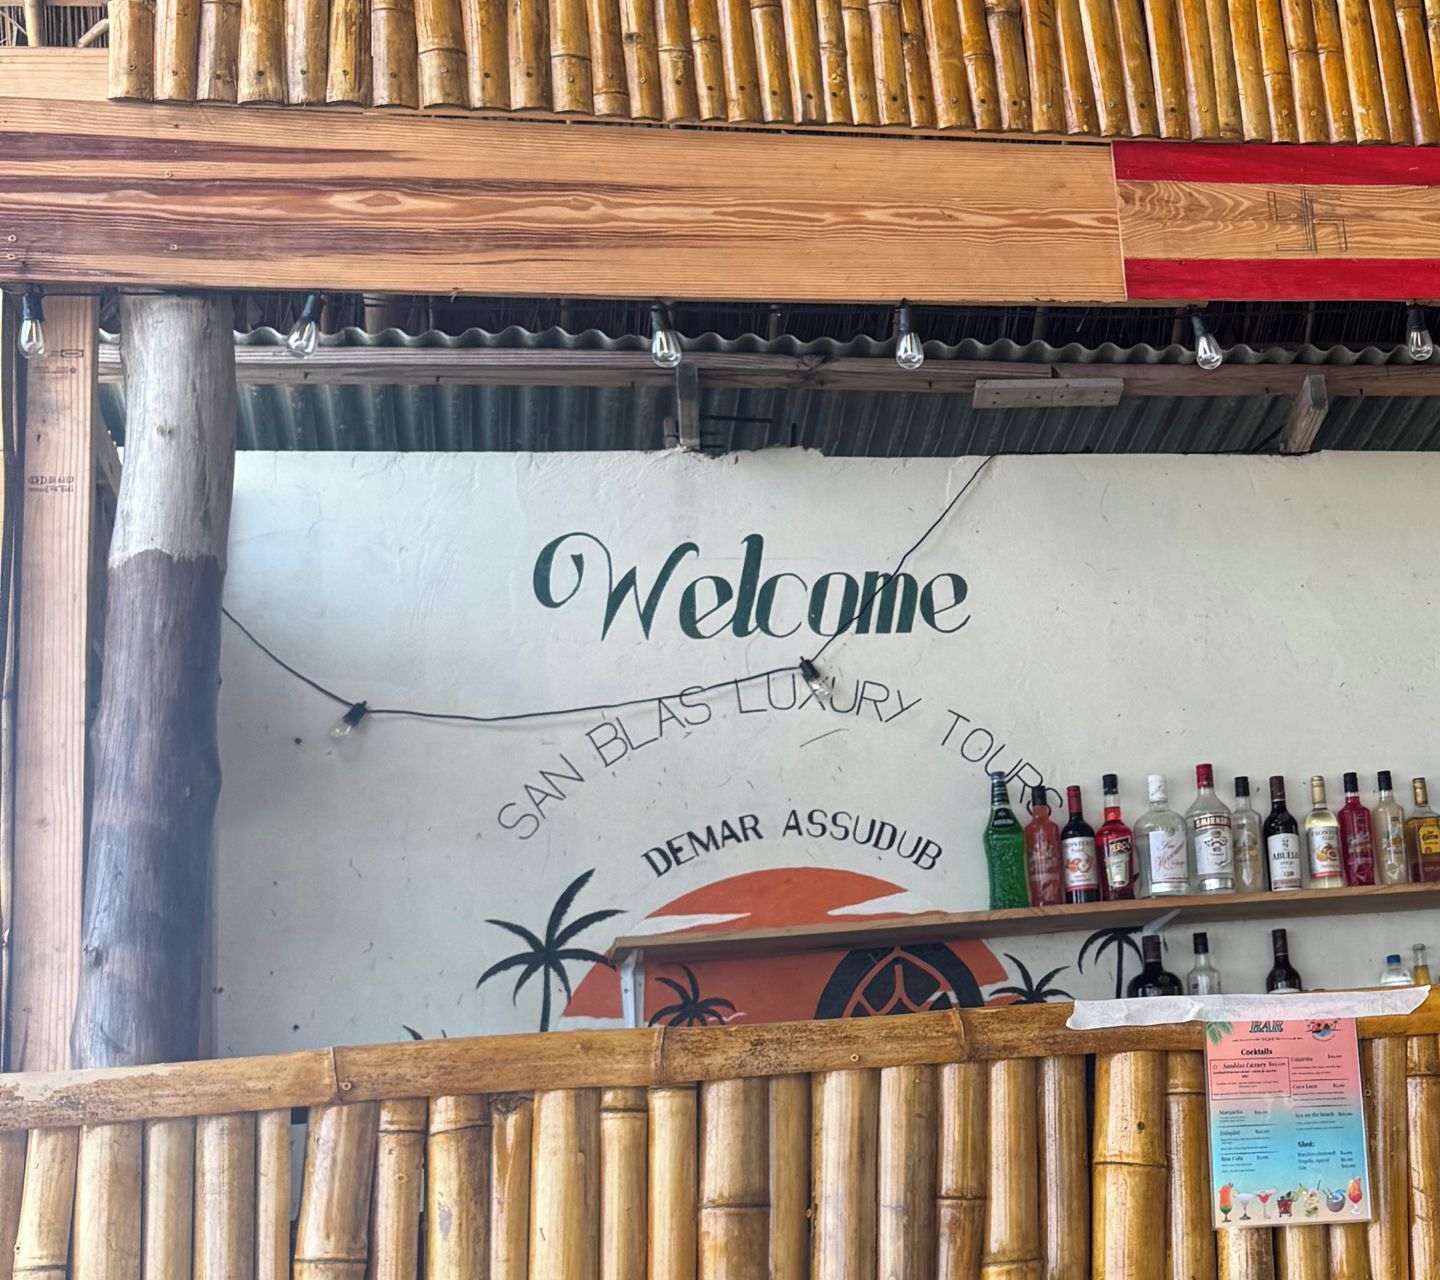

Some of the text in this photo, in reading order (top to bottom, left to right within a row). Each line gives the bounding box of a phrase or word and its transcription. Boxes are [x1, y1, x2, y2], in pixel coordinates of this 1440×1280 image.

[532, 531, 971, 641] Welcome
[497, 673, 1063, 840] SAN BLAS LUXURY TOURS
[641, 808, 944, 877] DEMAR ASSUDUB
[1241, 1048, 1273, 1056] Cocktails
[1249, 1019, 1284, 1033] BAR
